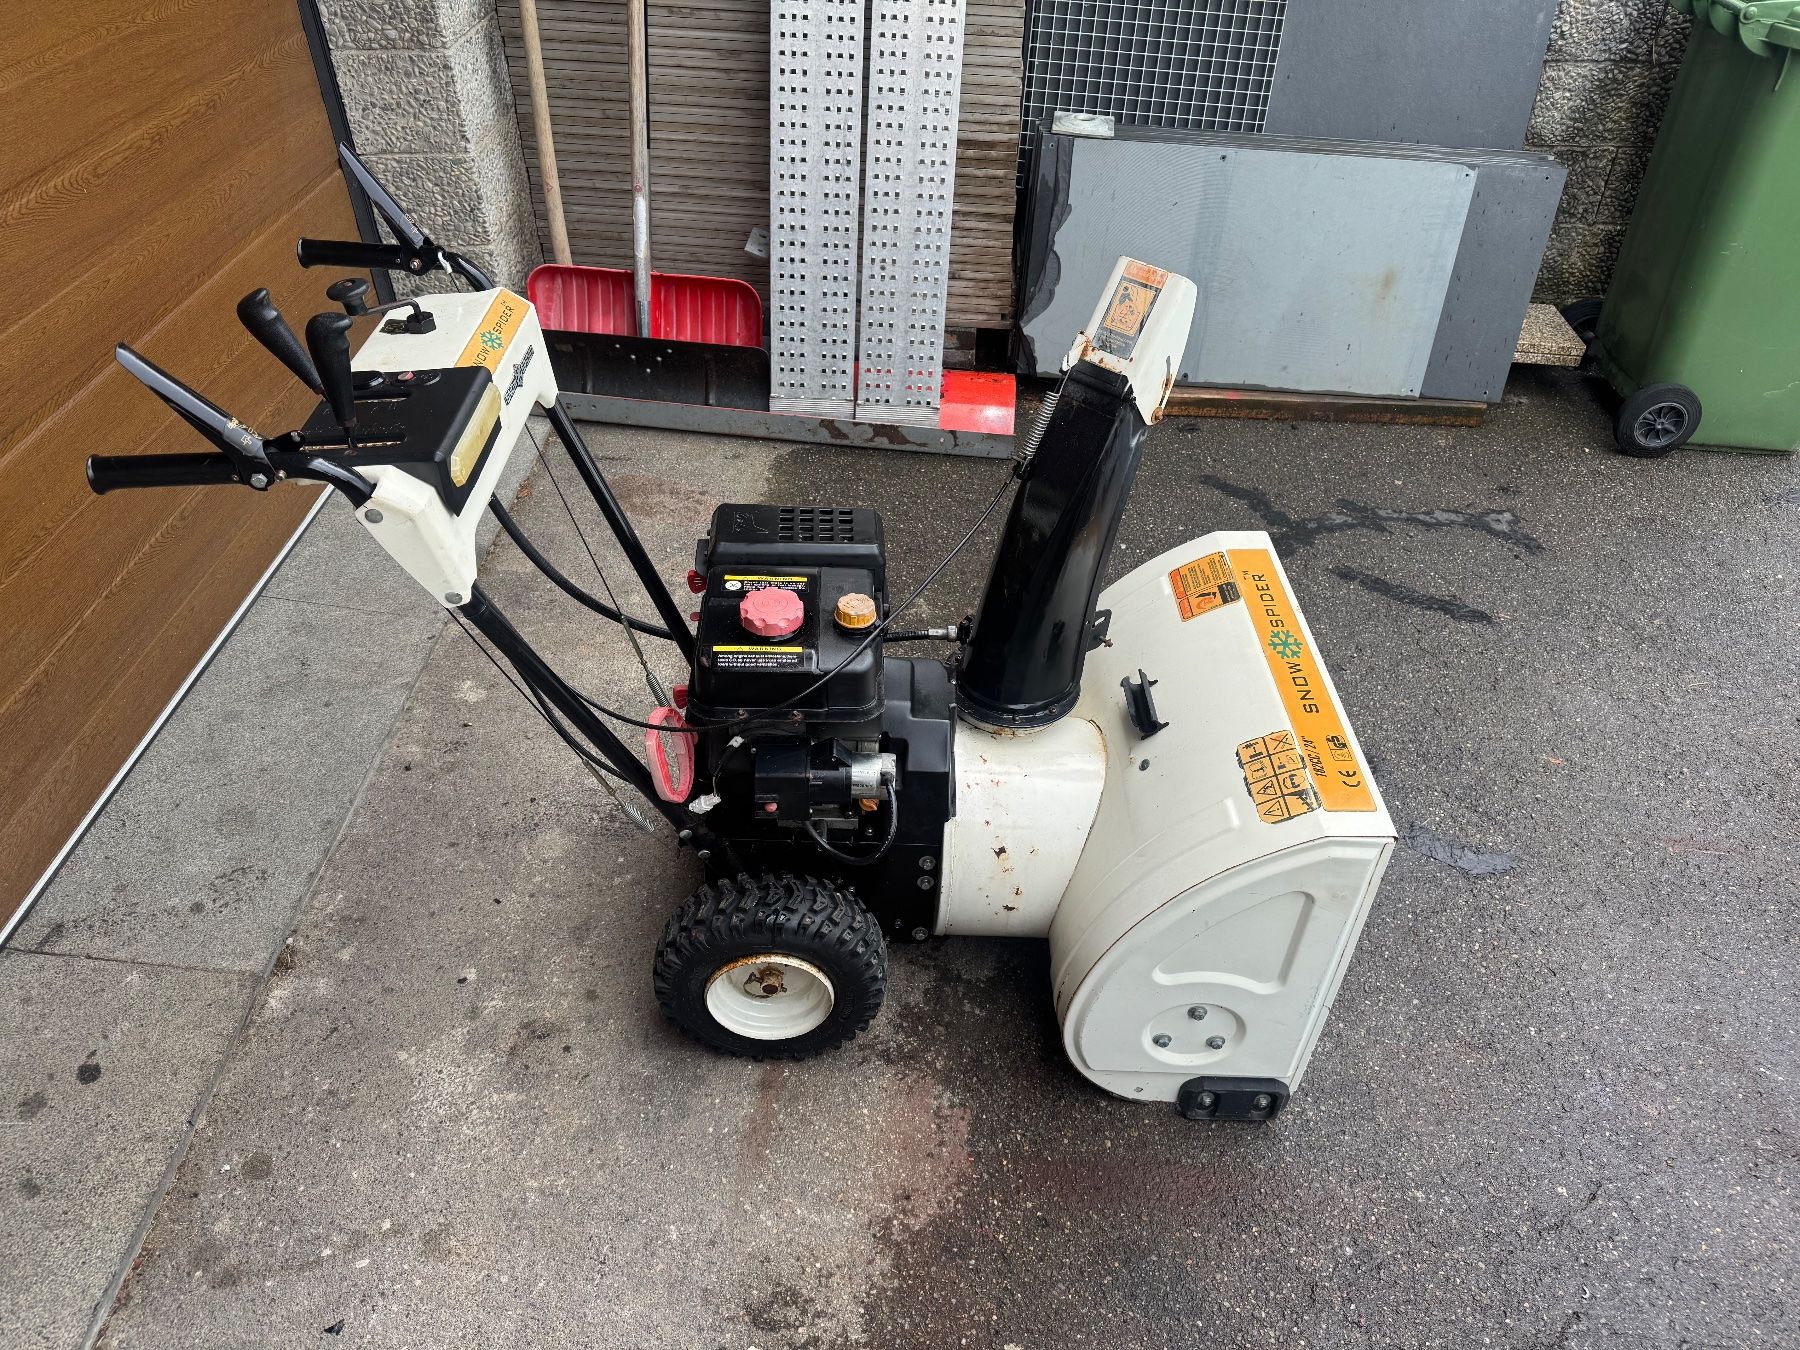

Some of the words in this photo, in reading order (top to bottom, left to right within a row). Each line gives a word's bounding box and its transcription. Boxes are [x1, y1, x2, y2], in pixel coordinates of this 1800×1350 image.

[474, 346, 490, 367] NOW
[493, 305, 515, 335] SPIDER
[1252, 573, 1285, 628] SPIDER
[1286, 661, 1320, 714] SNOW
